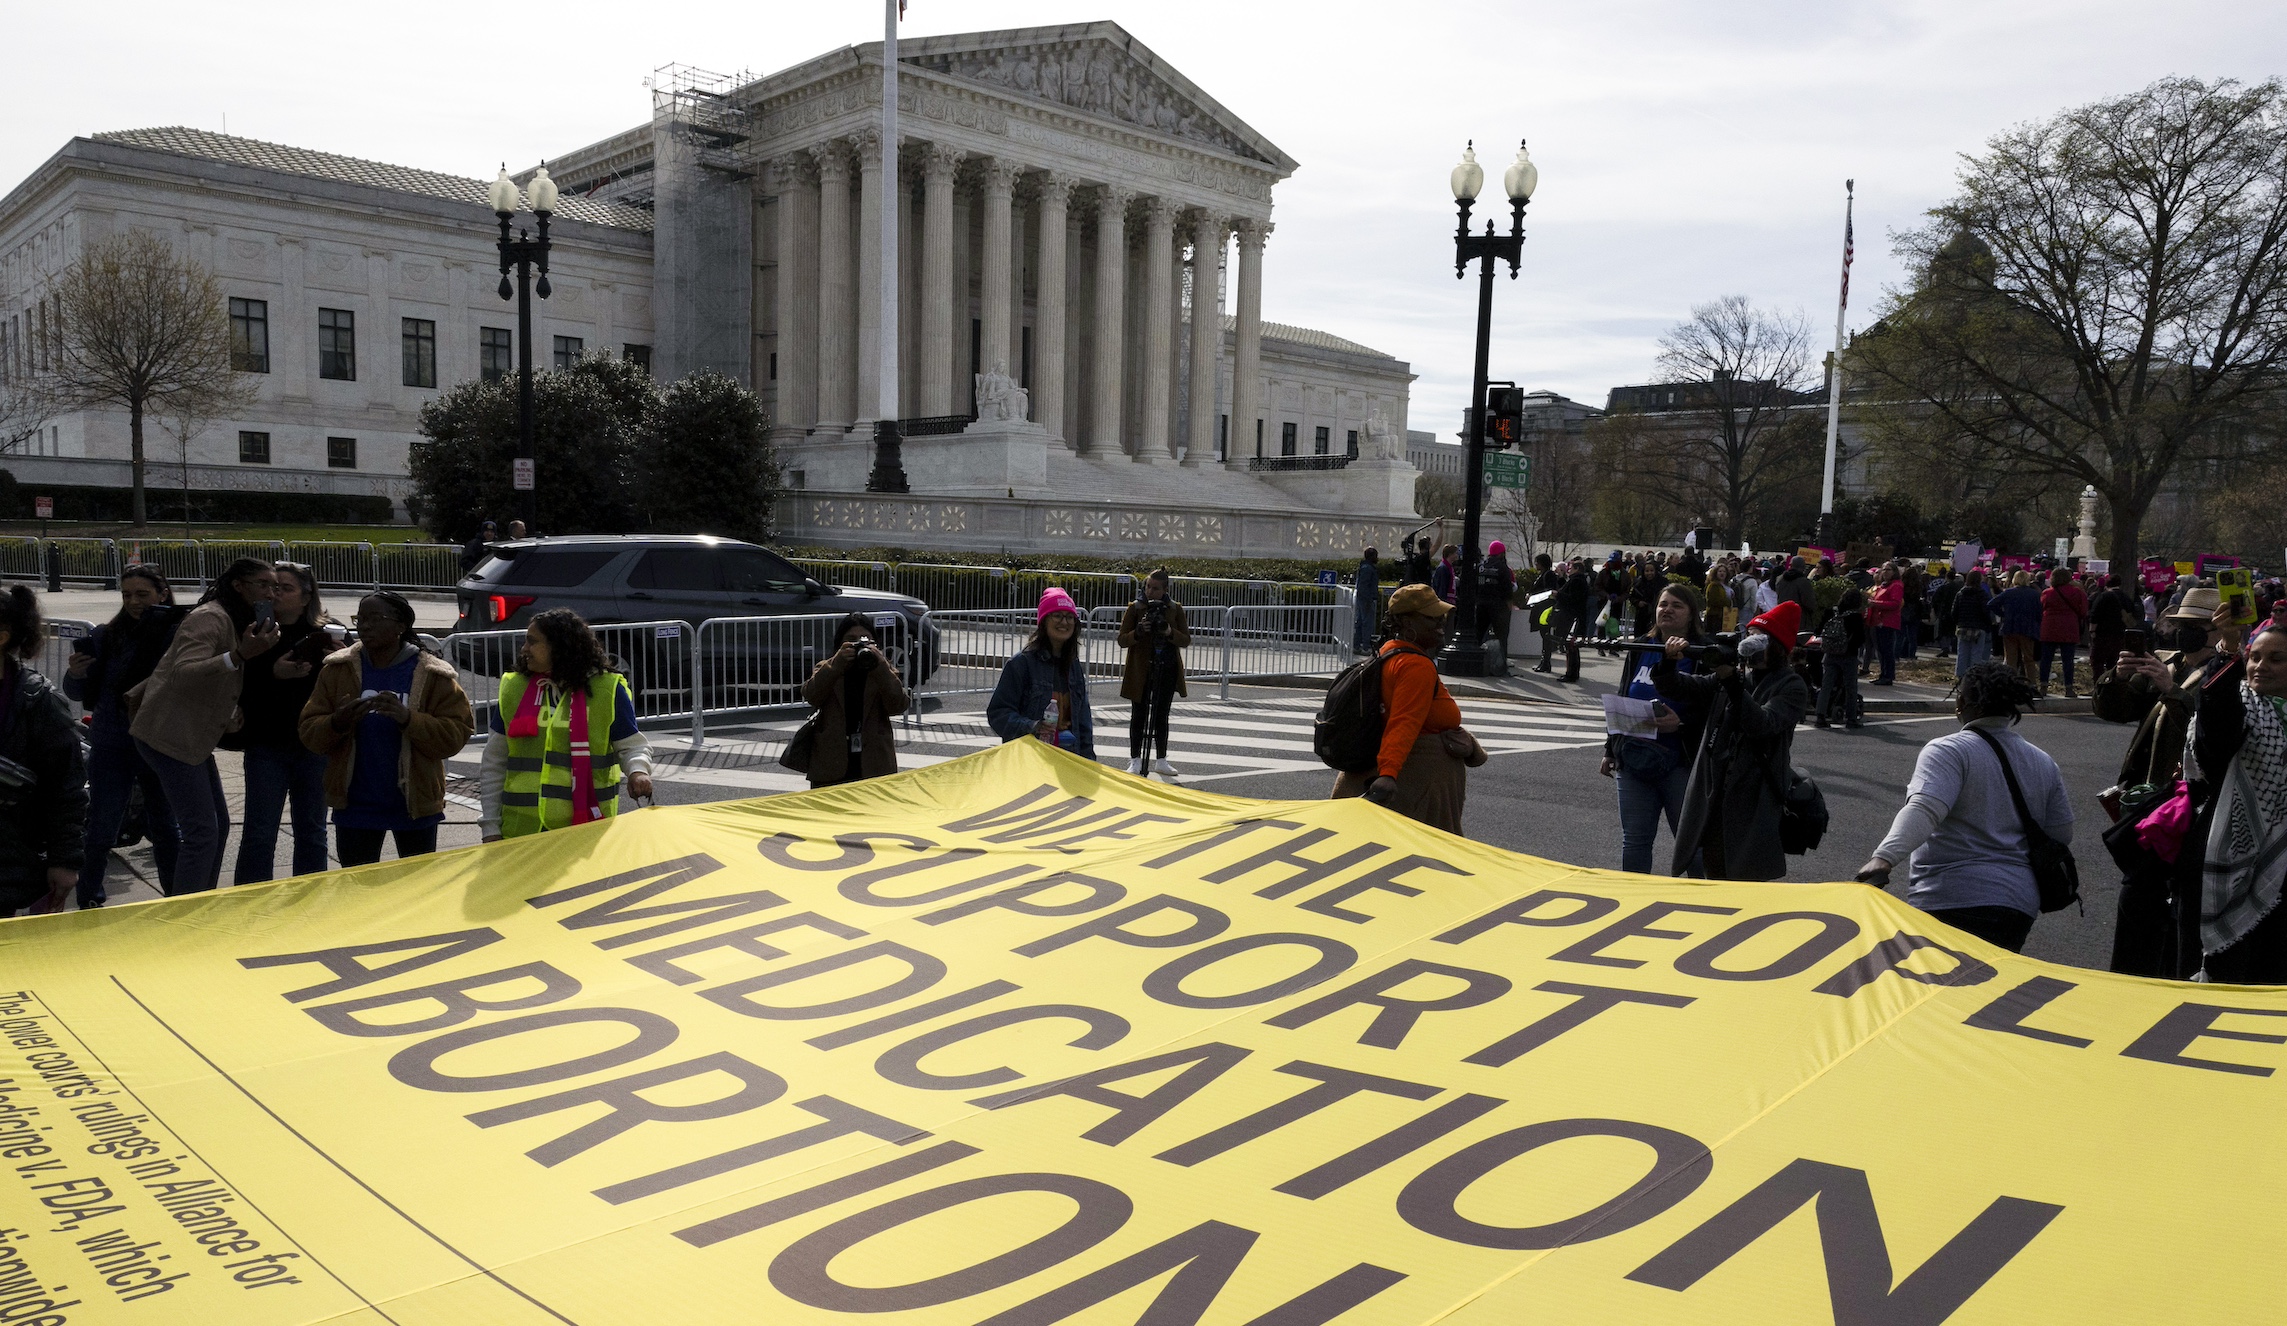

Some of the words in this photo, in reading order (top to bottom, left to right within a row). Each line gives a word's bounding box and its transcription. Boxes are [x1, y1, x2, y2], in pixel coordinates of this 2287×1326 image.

[1016, 124, 1057, 147] EQUAL
[1057, 136, 1103, 157] JUSTICE
[1107, 149, 1142, 166] UNDER
[1146, 160, 1167, 173] LAW
[757, 831, 1696, 1068] SUPPORT
[940, 783, 1190, 854] WE
[1139, 819, 1474, 925] THE
[1433, 889, 2287, 1077] PEOPLE
[0, 991, 33, 1016] The
[0, 1015, 60, 1050] lower
[26, 1051, 121, 1099] courts'
[525, 852, 2066, 1326] MEDICATION
[70, 1101, 161, 1160] rulings
[237, 927, 1410, 1326] ABORTION
[15, 1159, 68, 1179] v.
[126, 1154, 188, 1181] in
[30, 1176, 127, 1232] FDA,
[143, 1179, 261, 1257] Alliance
[76, 1228, 191, 1302] which
[223, 1252, 303, 1290] for
